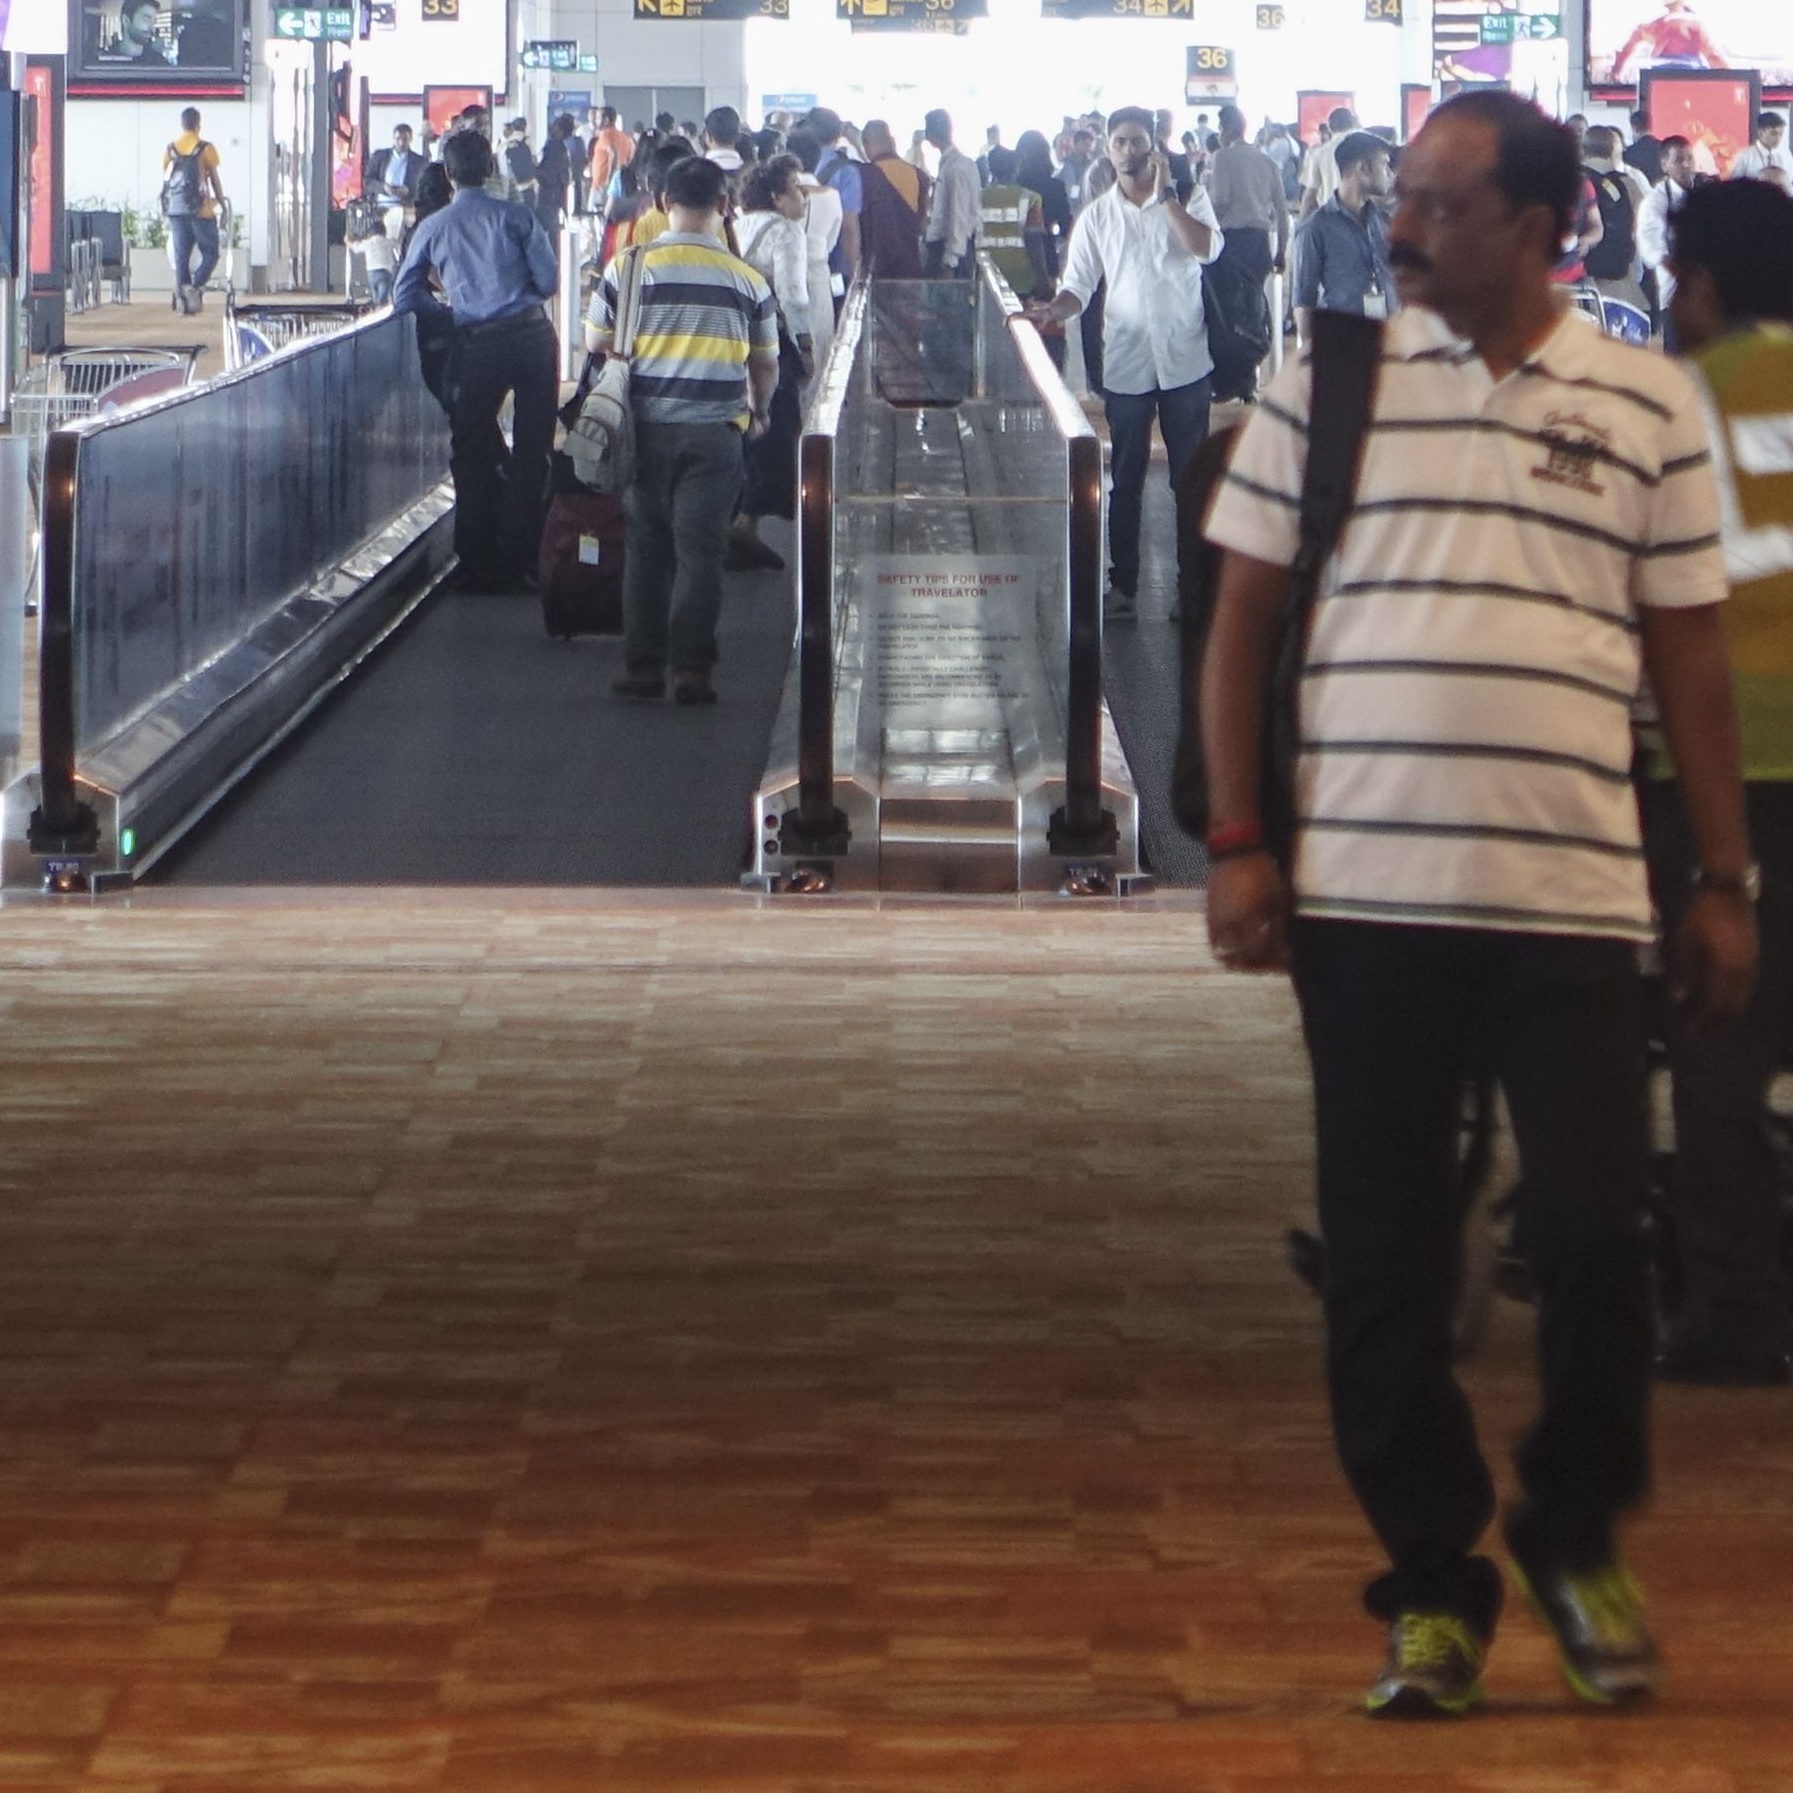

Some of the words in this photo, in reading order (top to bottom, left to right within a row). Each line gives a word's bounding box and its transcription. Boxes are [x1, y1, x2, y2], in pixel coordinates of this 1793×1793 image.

[327, 12, 351, 25] Exit
[1258, 9, 1285, 28] 36
[1197, 48, 1228, 69] 36
[877, 574, 922, 585] SAFETY
[925, 574, 949, 585] TIPS
[951, 574, 976, 585] FOR
[979, 574, 1002, 585] USE
[911, 588, 987, 598] TRAVELATOR
